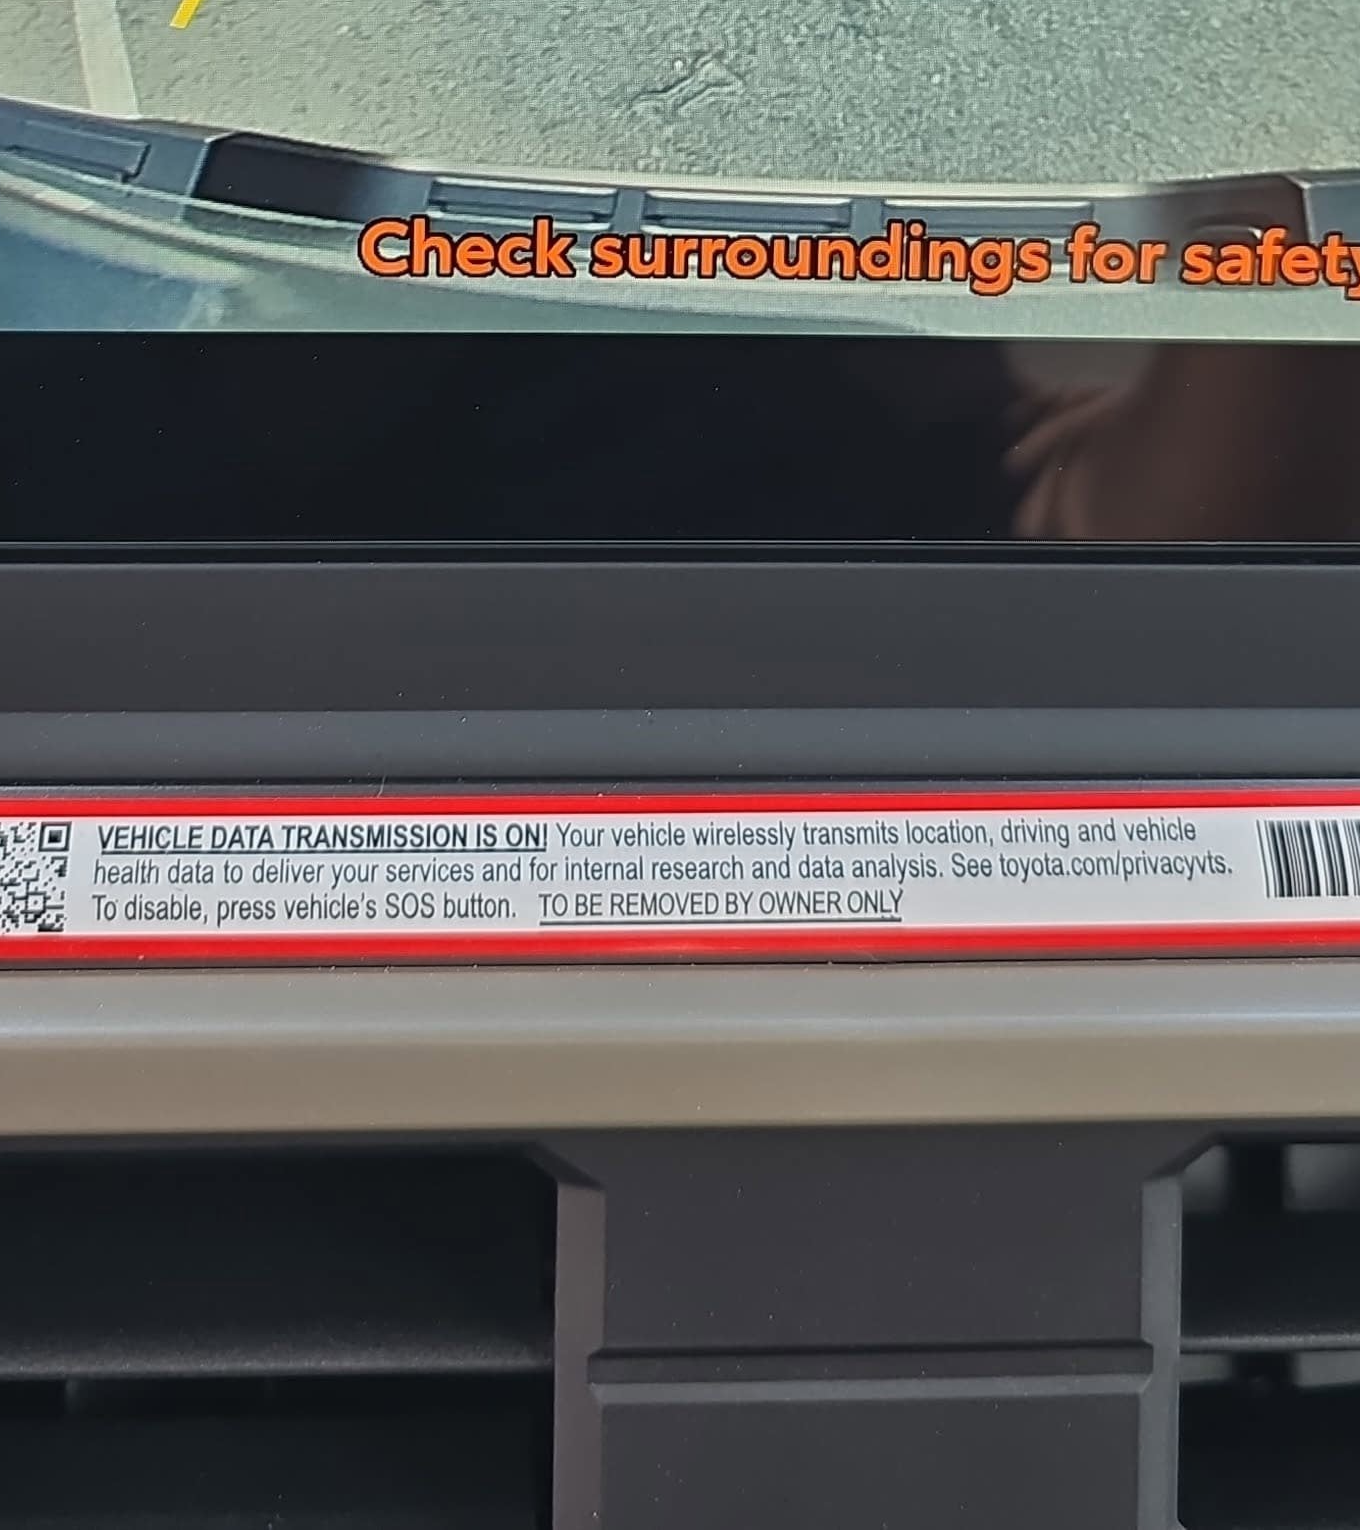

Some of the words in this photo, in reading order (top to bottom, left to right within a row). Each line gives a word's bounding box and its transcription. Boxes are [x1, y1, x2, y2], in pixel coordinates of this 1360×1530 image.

[360, 216, 572, 278] Check
[591, 221, 1050, 296] surroundings
[1068, 224, 1165, 283] for
[98, 825, 204, 850] VEHICLE
[211, 825, 275, 850] DATA
[281, 824, 468, 850] TRANSMISSION
[476, 824, 498, 848] IS
[505, 823, 548, 848] ON!
[556, 822, 605, 847] Your
[611, 821, 686, 847] vehicle
[692, 821, 796, 852] wirelessly
[803, 822, 899, 846] transmits
[905, 820, 994, 847] location,
[1001, 818, 1070, 849] driving
[1078, 817, 1116, 843] and
[1123, 817, 1196, 842] vehicle
[93, 858, 159, 885] health
[167, 858, 214, 884] data
[223, 860, 243, 884] to
[252, 858, 325, 884] deliver
[331, 864, 379, 890] your
[386, 860, 474, 883] services
[482, 856, 521, 882] and
[529, 856, 558, 882] for
[565, 856, 644, 881] internal
[651, 855, 744, 881] research
[752, 853, 791, 880] and
[798, 853, 845, 879] data
[852, 853, 943, 885] analysis.
[951, 852, 993, 878] See
[999, 850, 1233, 884] toyota.com/privacyvts.
[91, 894, 117, 922] To
[124, 893, 209, 924] disable,
[216, 900, 276, 928] press
[284, 892, 377, 920] vehicle's
[385, 892, 435, 919] SOS
[443, 892, 517, 919] button.
[538, 893, 568, 918] TO
[575, 893, 603, 917] BE
[610, 892, 719, 917] REMOVED
[725, 892, 754, 915] BY
[759, 891, 842, 915] OWNER
[847, 888, 904, 915] ONLY
